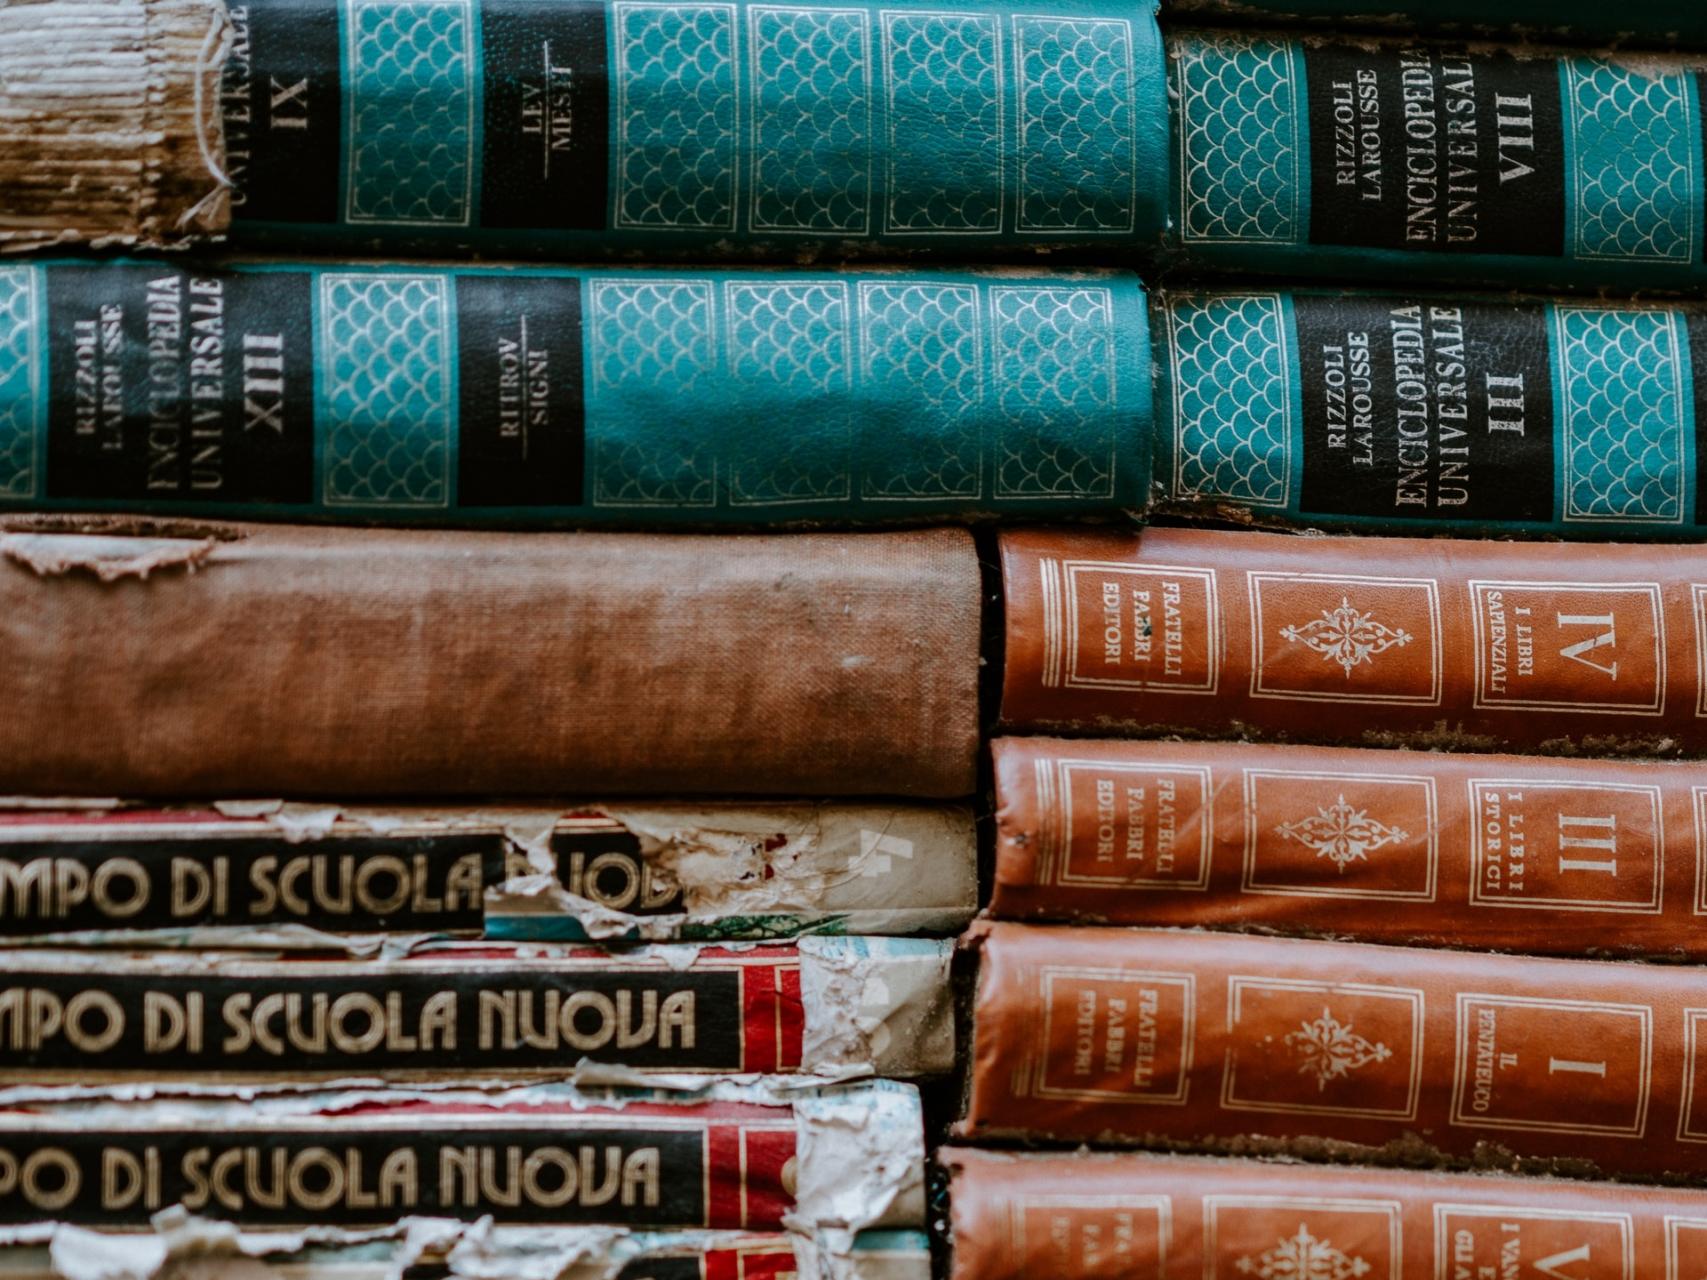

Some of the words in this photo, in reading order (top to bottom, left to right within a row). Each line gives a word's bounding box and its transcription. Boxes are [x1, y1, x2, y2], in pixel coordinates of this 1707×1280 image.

[271, 74, 308, 129] IX
[522, 82, 544, 134] LEV
[1332, 80, 1356, 185] RIZZOLI
[1356, 69, 1382, 201] LAROUSSE
[1400, 48, 1438, 242] ENCICLOPEDIA
[1441, 53, 1478, 242] UNIVERSAL
[1495, 92, 1536, 185] VIII
[75, 319, 98, 435] RIZZOLI
[146, 275, 181, 489] ENCICLOPEDIA
[189, 277, 224, 489] UNIVERSALE
[243, 333, 284, 434] XIII
[500, 337, 519, 438] RITROV
[528, 350, 549, 426] SIGNI
[1323, 344, 1347, 449] RIZZOLI
[1347, 331, 1373, 467] LAROUSSE
[1390, 305, 1429, 508] ENCICLOPEDIA
[1430, 306, 1470, 507] UNIVERSALE
[1485, 372, 1525, 436] III
[1102, 581, 1122, 665] EDITORI
[1132, 589, 1152, 662] FABBRI
[1162, 581, 1182, 676] FRATELLI
[1486, 590, 1507, 694] SAPIENZIALI
[1516, 624, 1534, 677] LIBRI
[1556, 611, 1618, 681] IV
[1096, 779, 1115, 862] EDITORI
[1126, 786, 1145, 860] FABBRI
[1156, 778, 1176, 873] FRATELLI
[1485, 792, 1501, 889] STORICI
[1509, 814, 1525, 890] LIBRI
[1558, 812, 1617, 877] III
[171, 856, 230, 918] DI
[249, 853, 483, 917] SCUOLA
[143, 990, 204, 1054] DI
[222, 990, 458, 1056] SCUOLA
[478, 989, 696, 1051] NUOVA
[1104, 998, 1127, 1073] FABBRI
[1134, 989, 1158, 1087] FRATELLI
[1472, 1008, 1497, 1113] PENTATEUCO
[1500, 1052, 1519, 1070] IL
[1550, 1056, 1607, 1079] I
[101, 1147, 162, 1211] DI
[180, 1146, 419, 1212] SCUOLA
[438, 1145, 661, 1208] NUOVA
